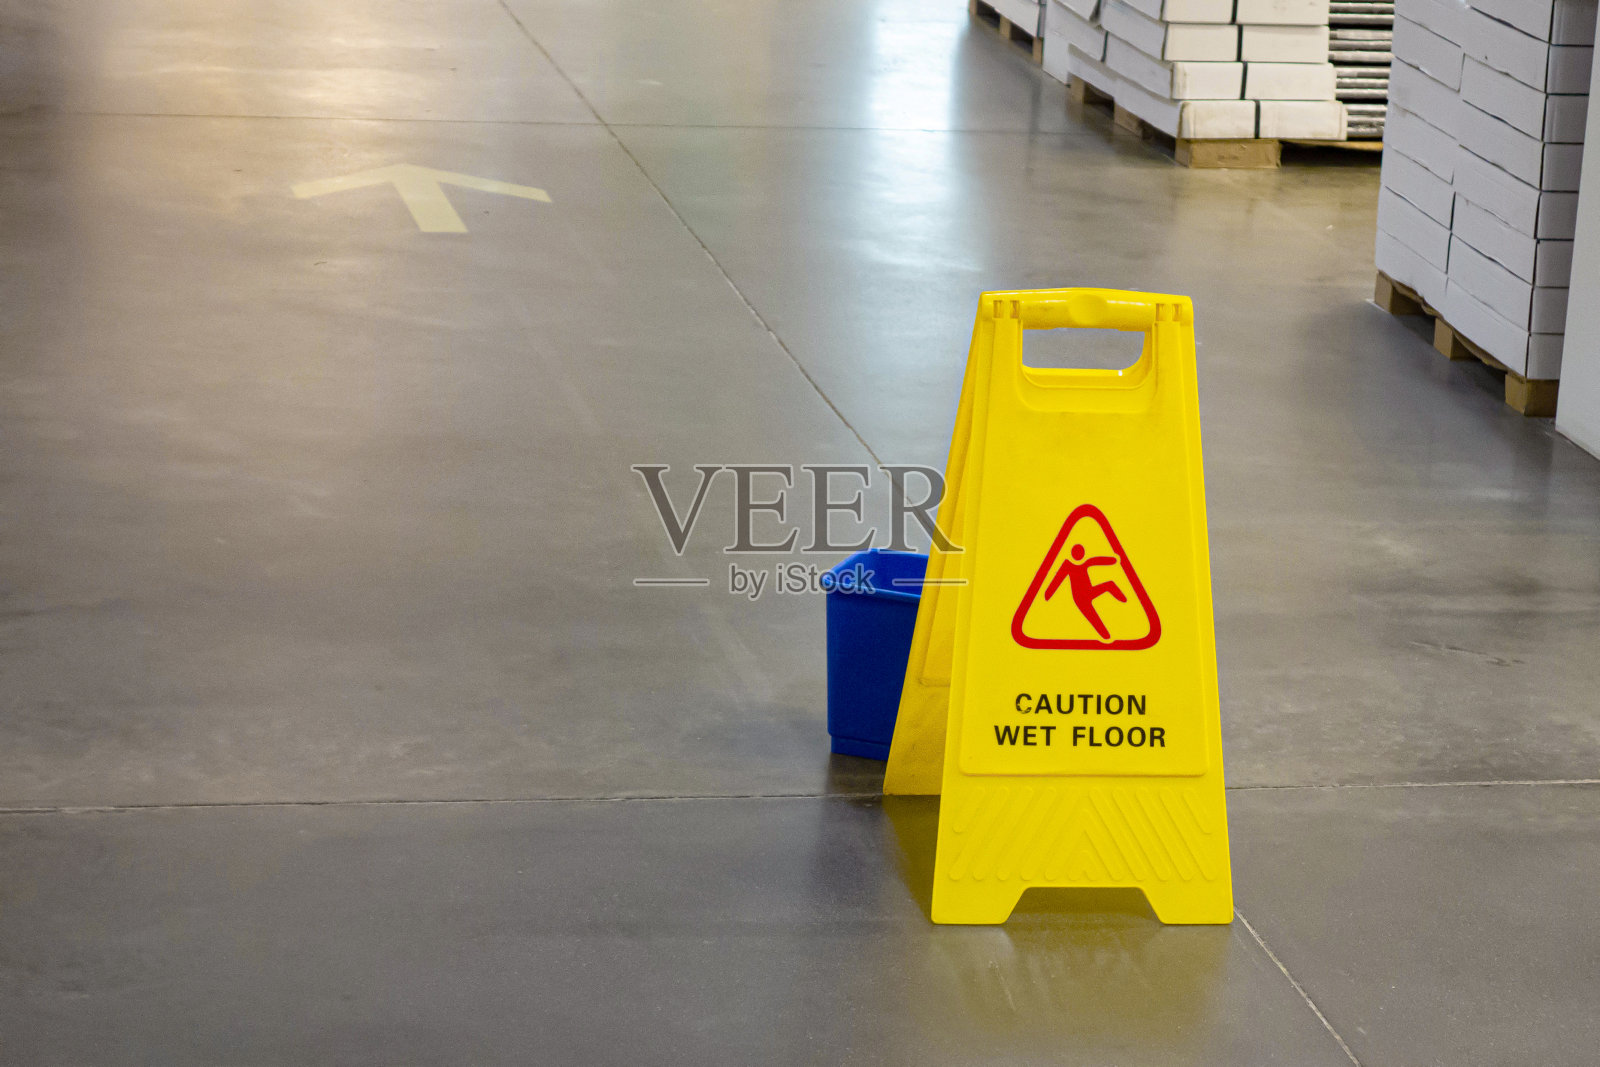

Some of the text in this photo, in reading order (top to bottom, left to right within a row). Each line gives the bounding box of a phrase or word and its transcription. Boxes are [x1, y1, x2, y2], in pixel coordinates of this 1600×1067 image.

[1015, 693, 1147, 716] CAUTION
[993, 725, 1166, 748] WET FLOOR
